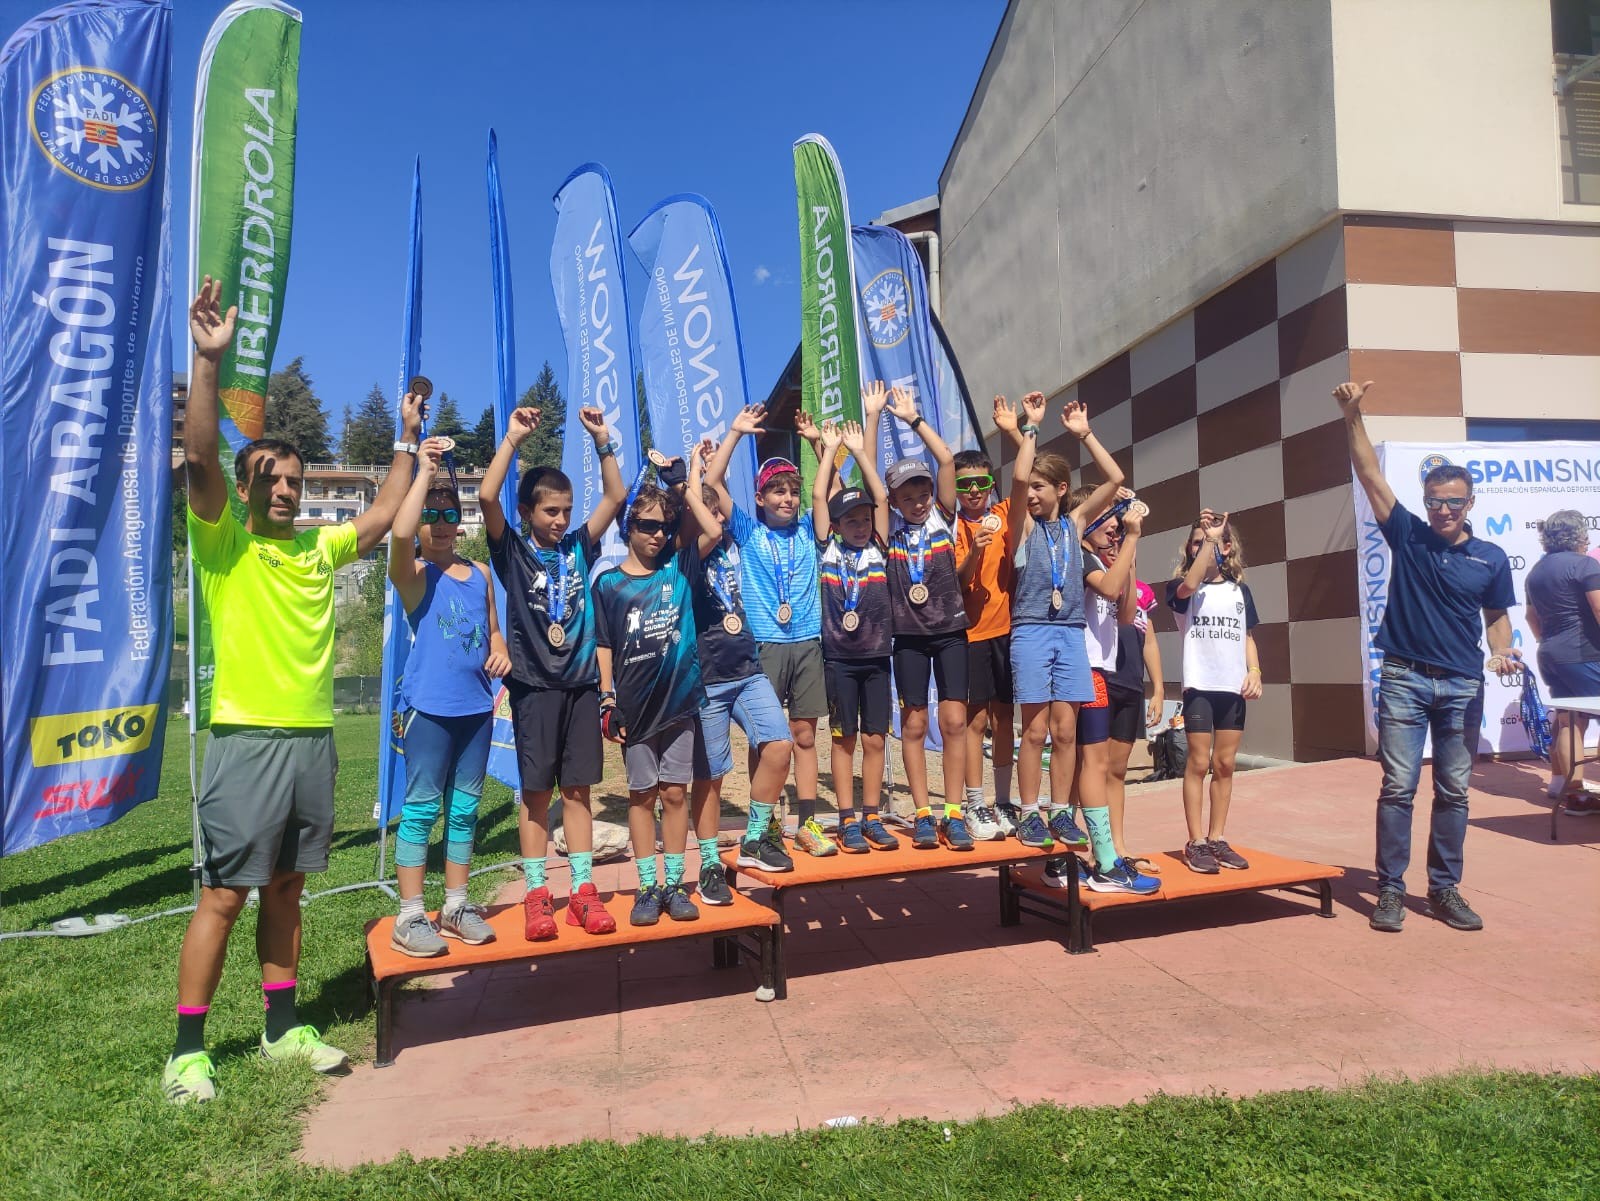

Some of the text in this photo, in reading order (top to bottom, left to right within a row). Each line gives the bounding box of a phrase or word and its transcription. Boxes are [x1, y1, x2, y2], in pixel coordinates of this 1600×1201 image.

[86, 110, 113, 122] FADI
[40, 131, 88, 177] INVIERNO
[235, 87, 276, 378] IBERDROLA
[33, 237, 117, 667] FADI ARAGÓN
[117, 255, 150, 661] Federación Aragonesa de Deportes de Invierno
[1190, 628, 1241, 642] ski taldea
[57, 711, 146, 759] TOKO
